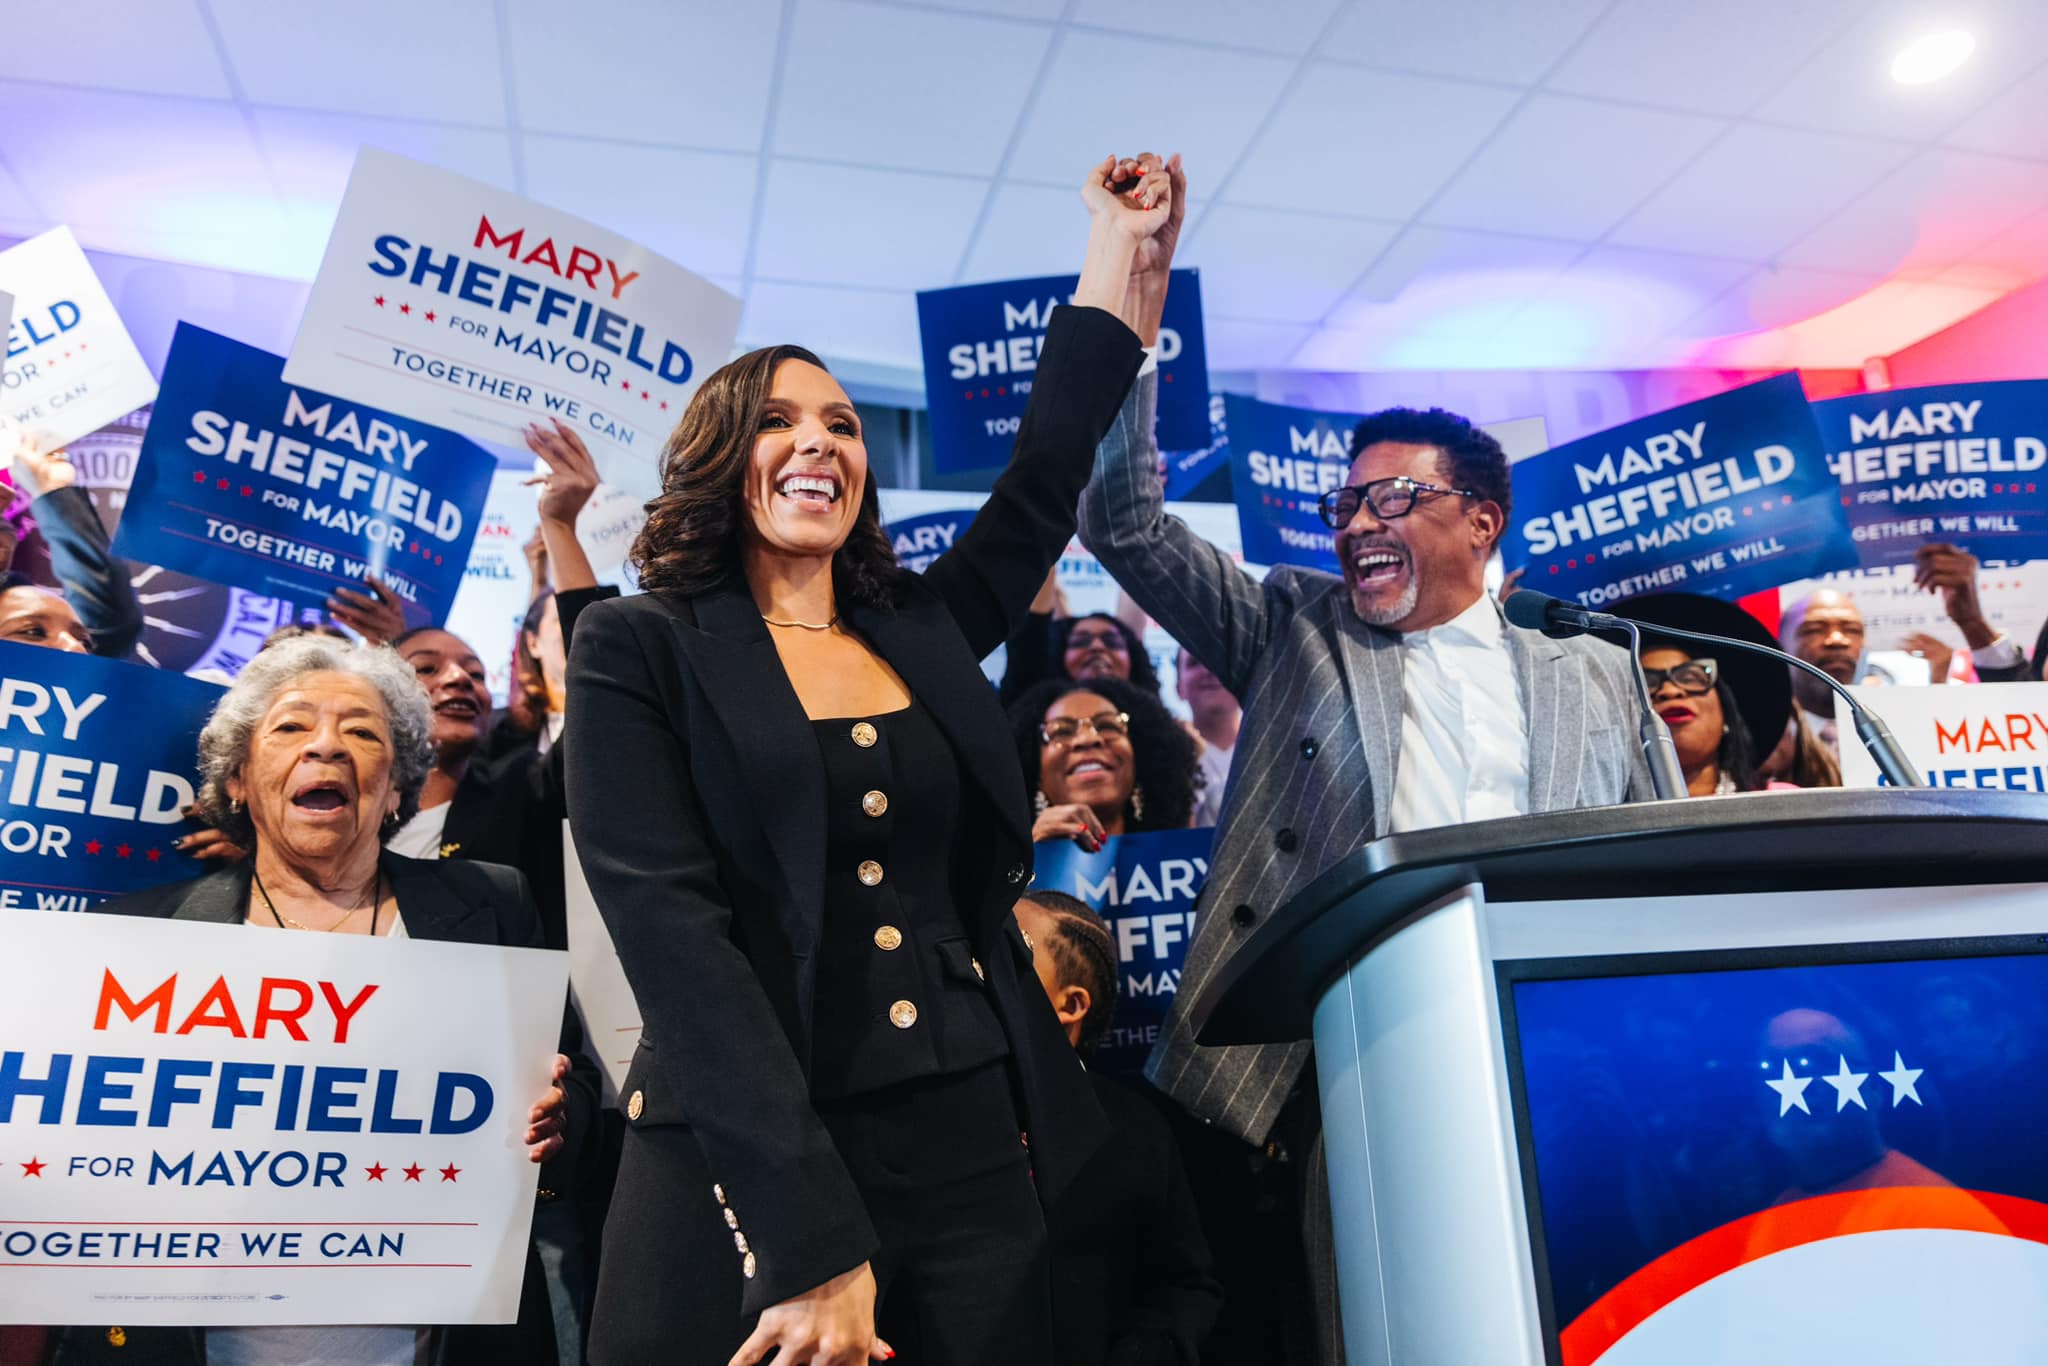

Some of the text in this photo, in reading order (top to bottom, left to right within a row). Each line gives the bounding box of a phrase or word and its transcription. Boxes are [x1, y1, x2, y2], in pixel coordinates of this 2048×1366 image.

[474, 214, 640, 300] MARY
[367, 234, 694, 385] SHEFFIELD
[448, 316, 612, 386] FOR MAYOR
[283, 389, 429, 471] MARY
[391, 347, 635, 446] TOGETHER WE CAN
[1850, 400, 1983, 445] MARY
[185, 410, 463, 543] SHEFFIELD
[1573, 421, 1707, 494] MARY
[1857, 477, 1987, 504] FOR MAYOR
[262, 489, 406, 552] FOR MAYOR
[1522, 444, 1796, 555] SHEFFIELD
[1602, 505, 1736, 559] FOR MAYOR
[1940, 515, 1970, 533] WE
[1975, 516, 2019, 532] WILL
[206, 519, 334, 572] TOGETHER
[1576, 537, 1785, 607] TOGETHER WE WILL
[0, 817, 72, 858] OR
[94, 966, 379, 1044] MARY
[0, 1050, 494, 1136] HEFFIELD
[68, 1150, 347, 1188] FOR MAYOR
[0, 1231, 404, 1259] OGETHER WE CAN
